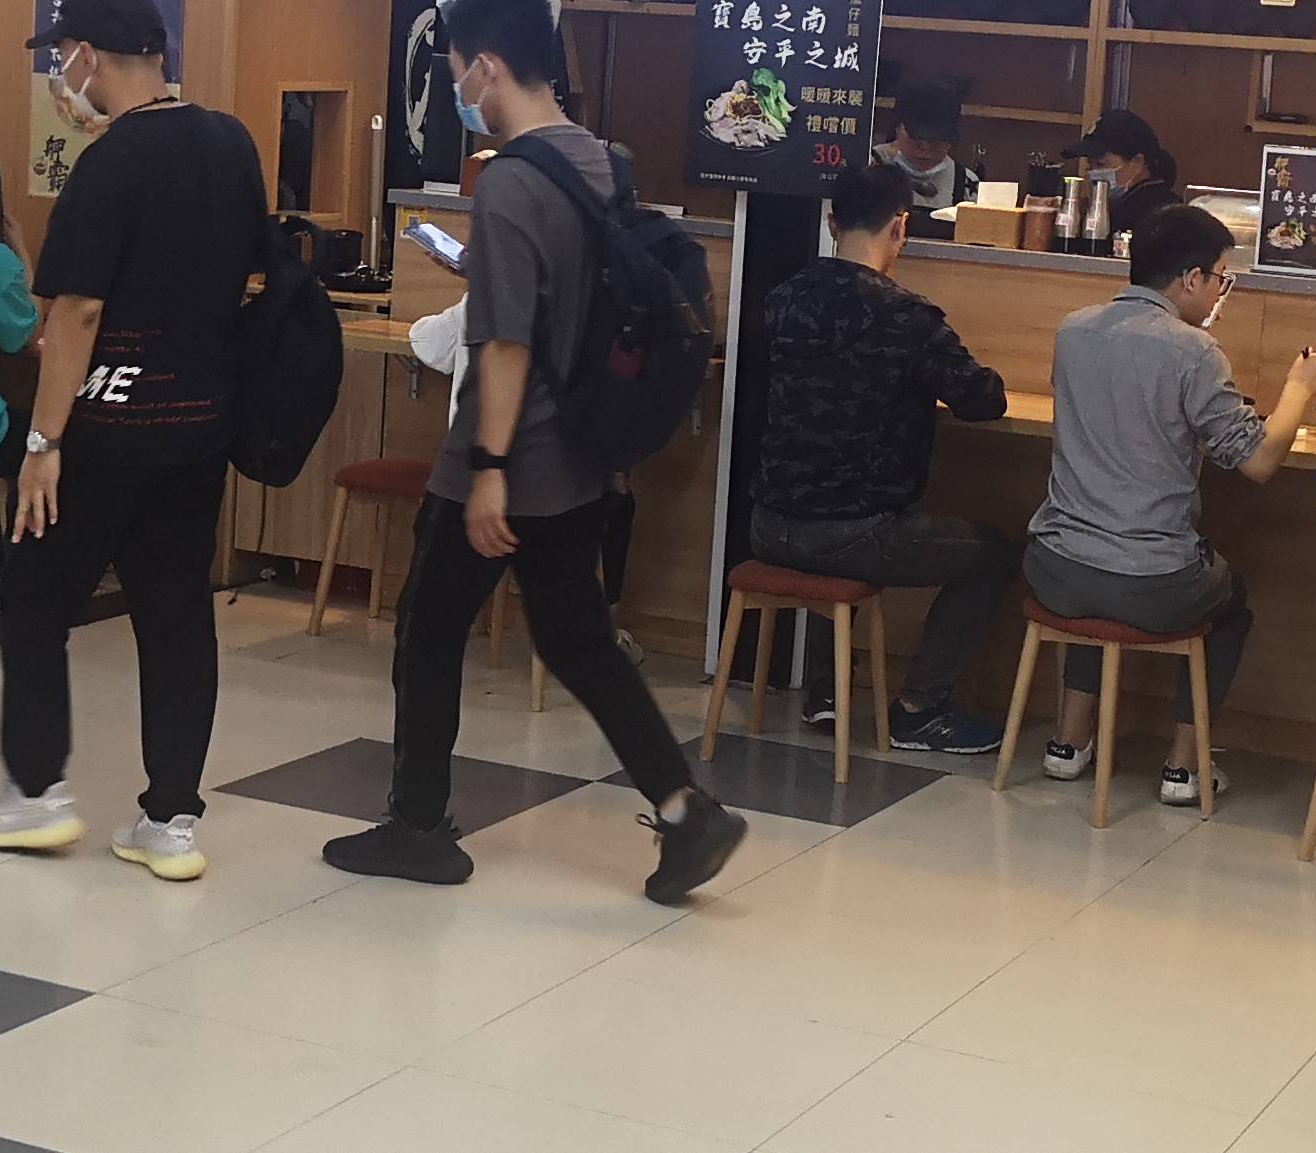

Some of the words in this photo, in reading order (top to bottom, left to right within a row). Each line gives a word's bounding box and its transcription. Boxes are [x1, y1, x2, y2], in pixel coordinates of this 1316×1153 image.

[711, 0, 826, 35] 寶島之南
[742, 36, 861, 73] 安平之城
